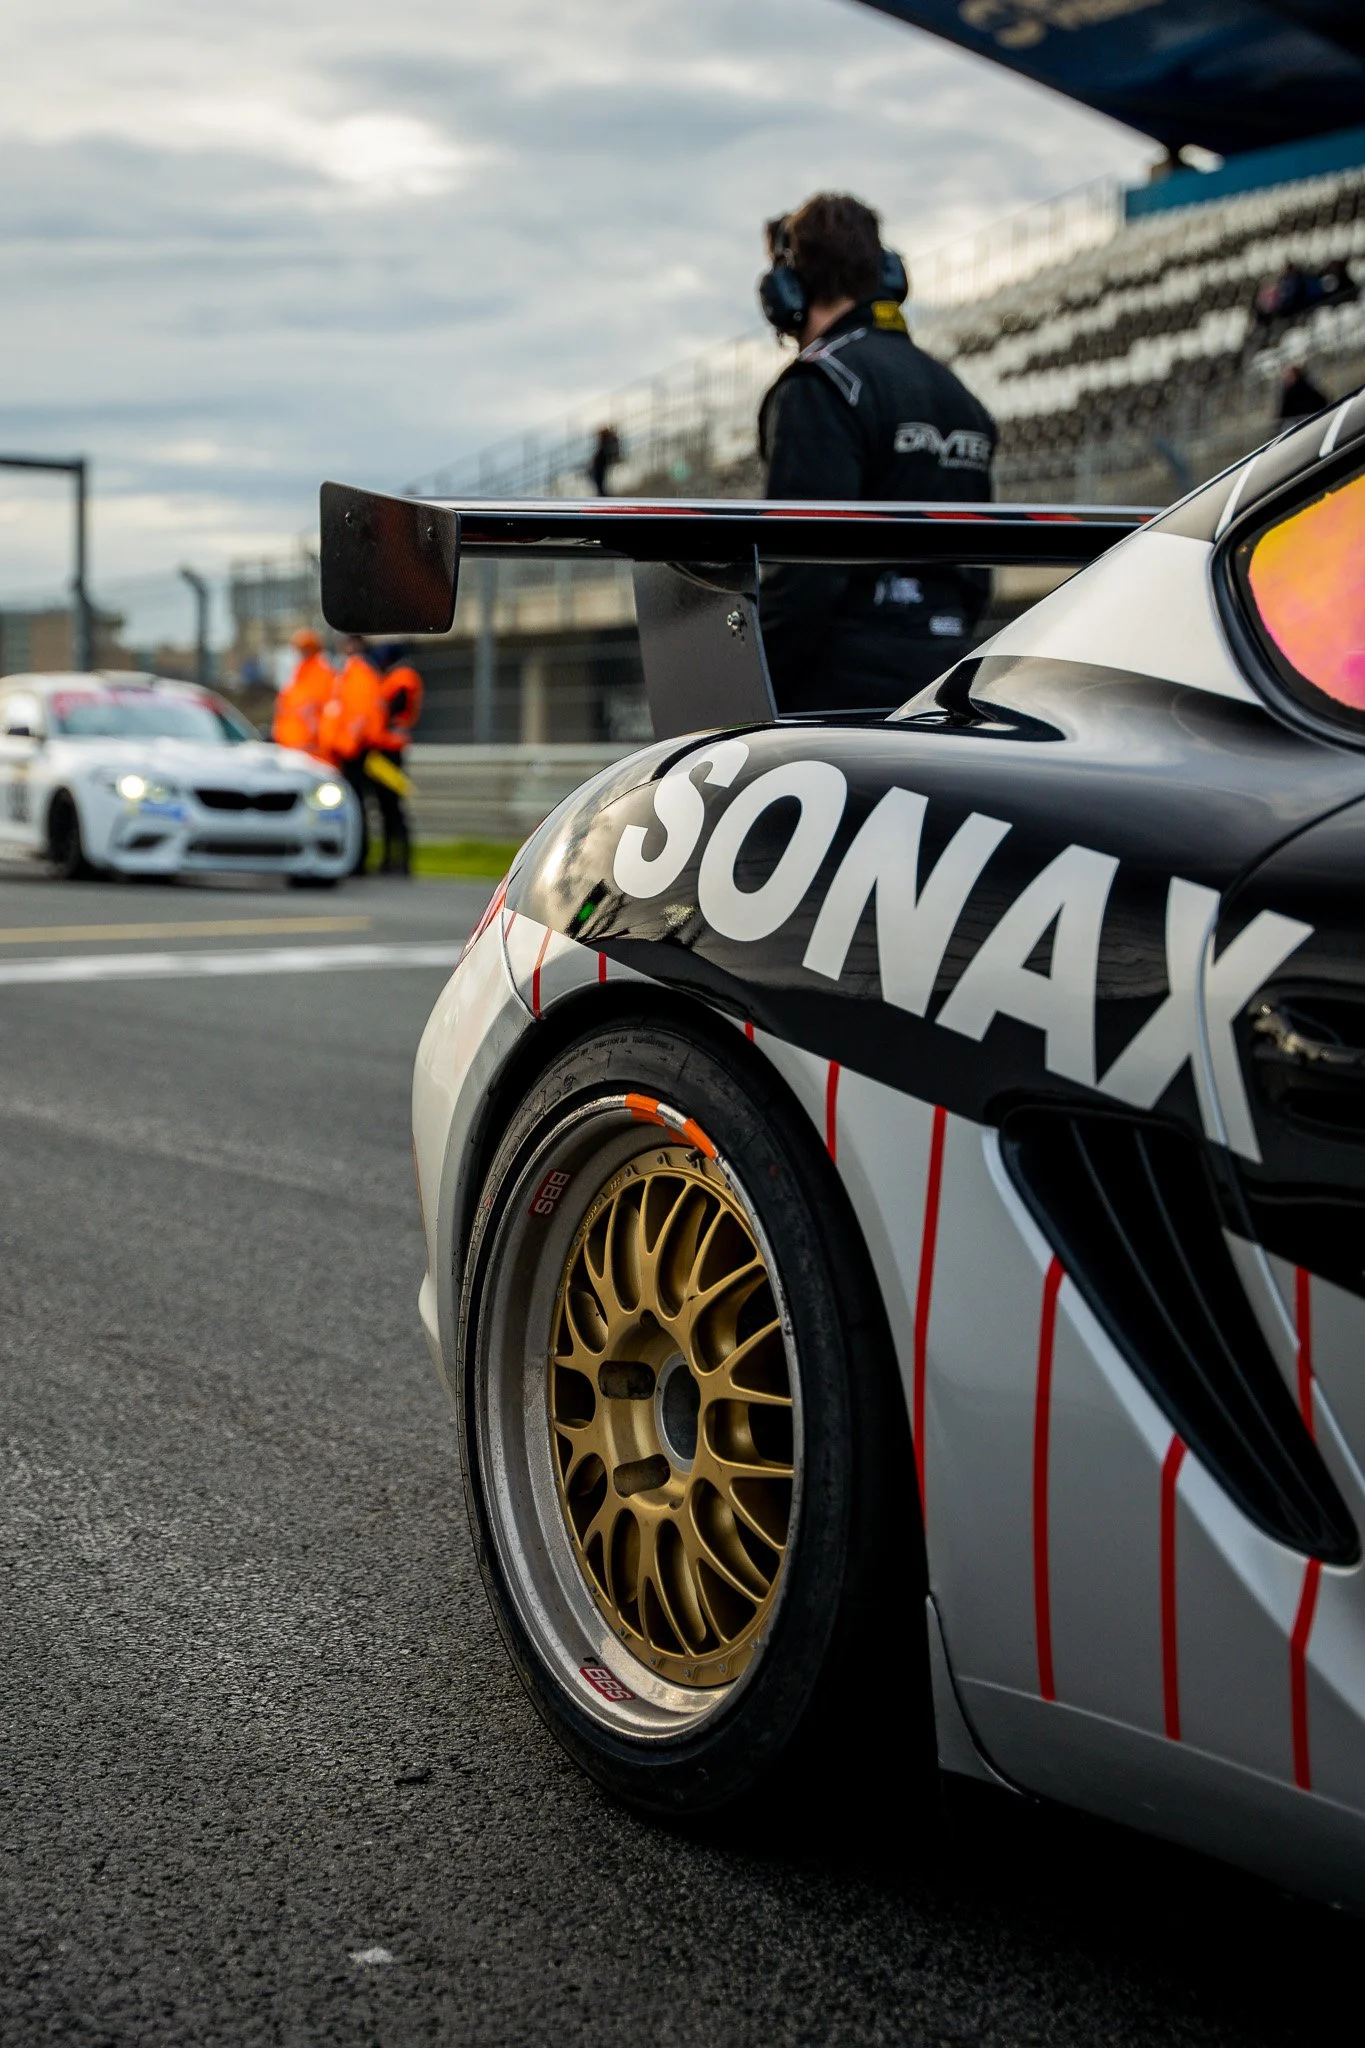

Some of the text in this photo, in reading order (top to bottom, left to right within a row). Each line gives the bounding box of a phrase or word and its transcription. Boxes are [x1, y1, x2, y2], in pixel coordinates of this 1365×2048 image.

[612, 740, 1314, 1164] SONAX
[534, 1171, 571, 1215] BBS
[584, 1669, 631, 1699] BBS
